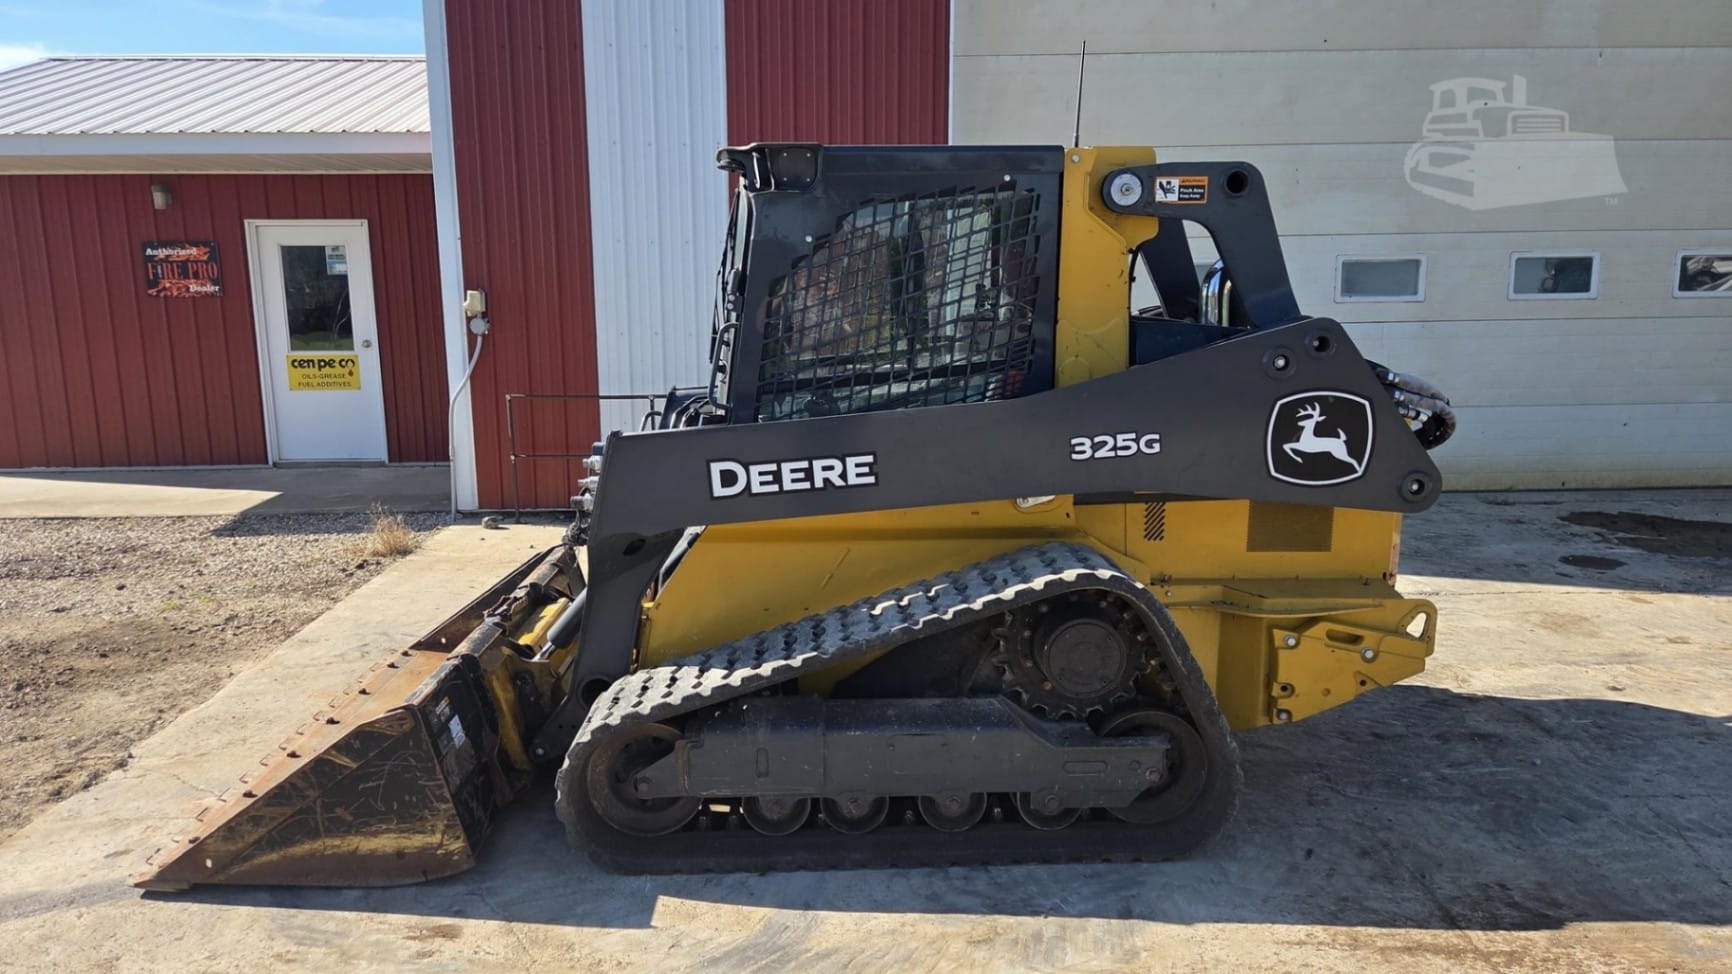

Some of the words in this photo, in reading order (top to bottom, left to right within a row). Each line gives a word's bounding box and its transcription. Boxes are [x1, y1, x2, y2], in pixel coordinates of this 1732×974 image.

[188, 262, 218, 279] PRO
[189, 284, 220, 292] Dealer
[1070, 432, 1161, 461] 325G
[708, 454, 877, 498] DEERE
